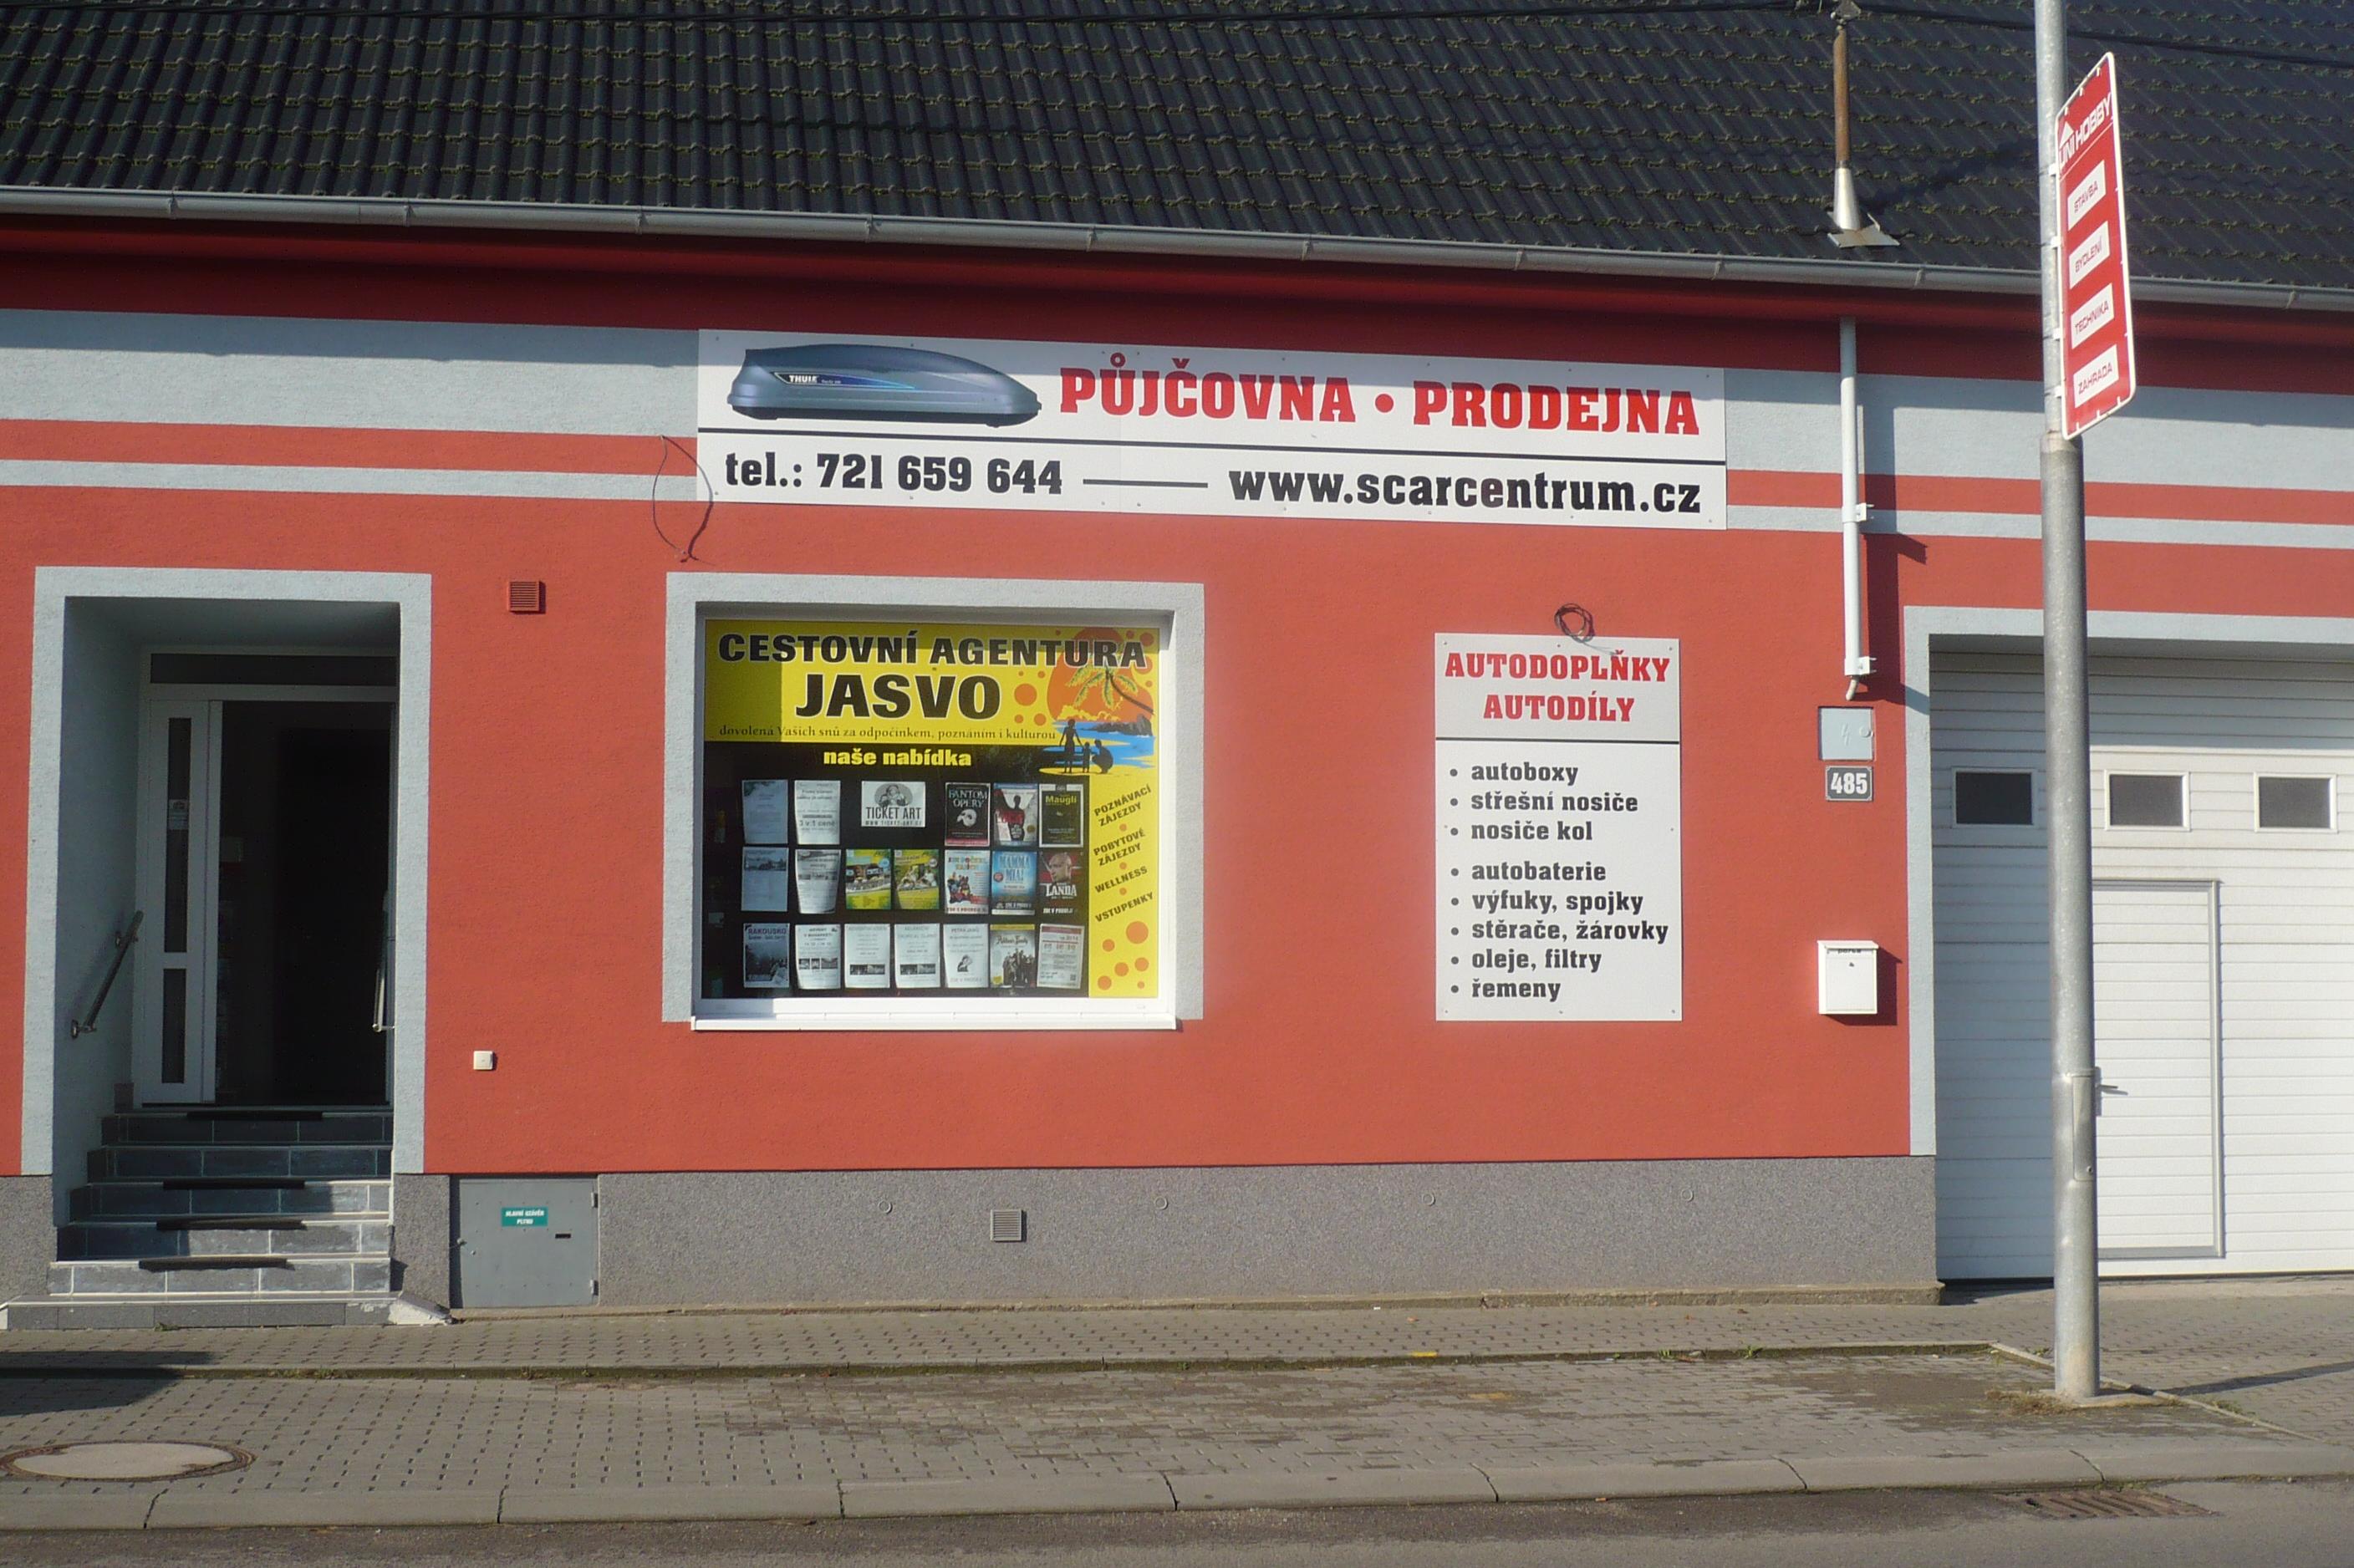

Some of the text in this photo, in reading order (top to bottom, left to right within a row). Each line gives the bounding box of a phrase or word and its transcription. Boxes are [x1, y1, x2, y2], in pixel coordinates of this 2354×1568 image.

[2074, 181, 2099, 213] STAVBA
[2075, 300, 2109, 335] TECHNIKA
[2078, 362, 2113, 395] ZAHRADA
[1060, 352, 1700, 435] PŮJČOVNA PRODEJNA
[726, 451, 1062, 495] tel.: 721 659 644
[1229, 471, 1701, 514] www.scarcentrum.cz
[718, 630, 1148, 669] CESTOVNÍ AGENTURA
[1444, 649, 1670, 683] AUTODOPLŇKY
[795, 672, 1001, 723] JASVO
[1483, 690, 1635, 722] AUTODÍLY
[719, 725, 774, 736] dovolená
[778, 725, 816, 737] Vašich
[843, 729, 856, 737] za
[938, 728, 996, 741] poznáním
[1006, 728, 1056, 740] kulturou
[823, 746, 972, 767] naše nabídka
[1471, 761, 1579, 787] autoboxy
[1830, 772, 1868, 795] 485
[866, 807, 922, 819] TICKET ART
[1045, 795, 1078, 805] Maugli
[1094, 784, 1152, 817] POZNÁVACÍ
[1471, 791, 1638, 812] střešní nosiče
[1098, 802, 1142, 827] ZÁJEZDY
[1093, 827, 1146, 856] POBYTOVÉ
[1471, 821, 1593, 841] nosiče kol
[1098, 843, 1142, 867] ZÁJEZDY
[1095, 866, 1149, 893] WELLNESS
[1471, 861, 1607, 881] autobaterie
[1046, 883, 1078, 897] LANDA
[1472, 889, 1643, 915] výfuky, spojky
[1095, 891, 1154, 922] VSTUPENKY
[1472, 919, 1669, 944] stěrače, žárovky
[1472, 949, 1602, 973] oleje, filtry
[1472, 978, 1562, 1002] řemeny
